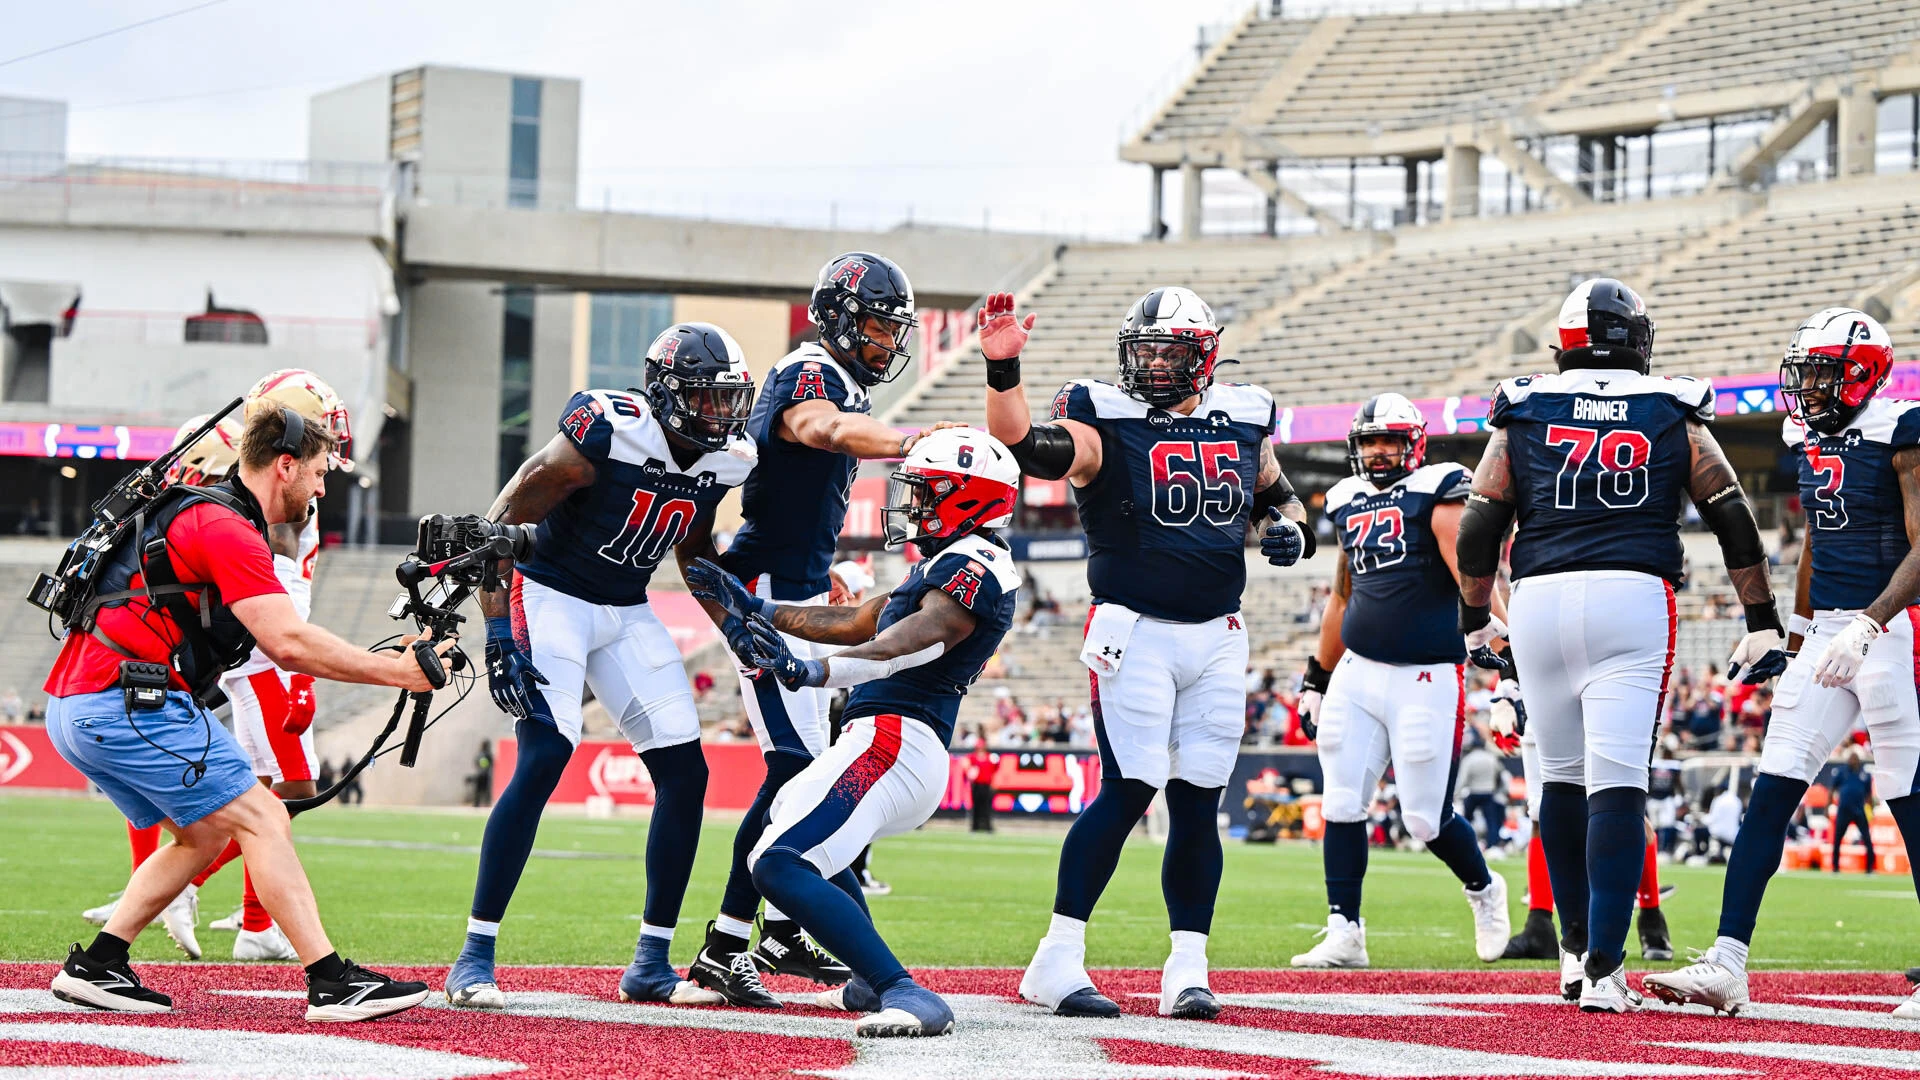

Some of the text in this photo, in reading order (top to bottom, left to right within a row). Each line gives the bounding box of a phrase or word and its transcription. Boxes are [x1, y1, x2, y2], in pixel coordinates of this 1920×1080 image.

[1573, 397, 1629, 422] BANNER
[957, 445, 974, 468] 6
[1149, 441, 1244, 526] 65
[1546, 424, 1651, 509] 78
[1814, 455, 1848, 529] 3
[598, 489, 697, 568] 10
[1346, 506, 1407, 574] 73
[760, 936, 790, 959] NIKE
